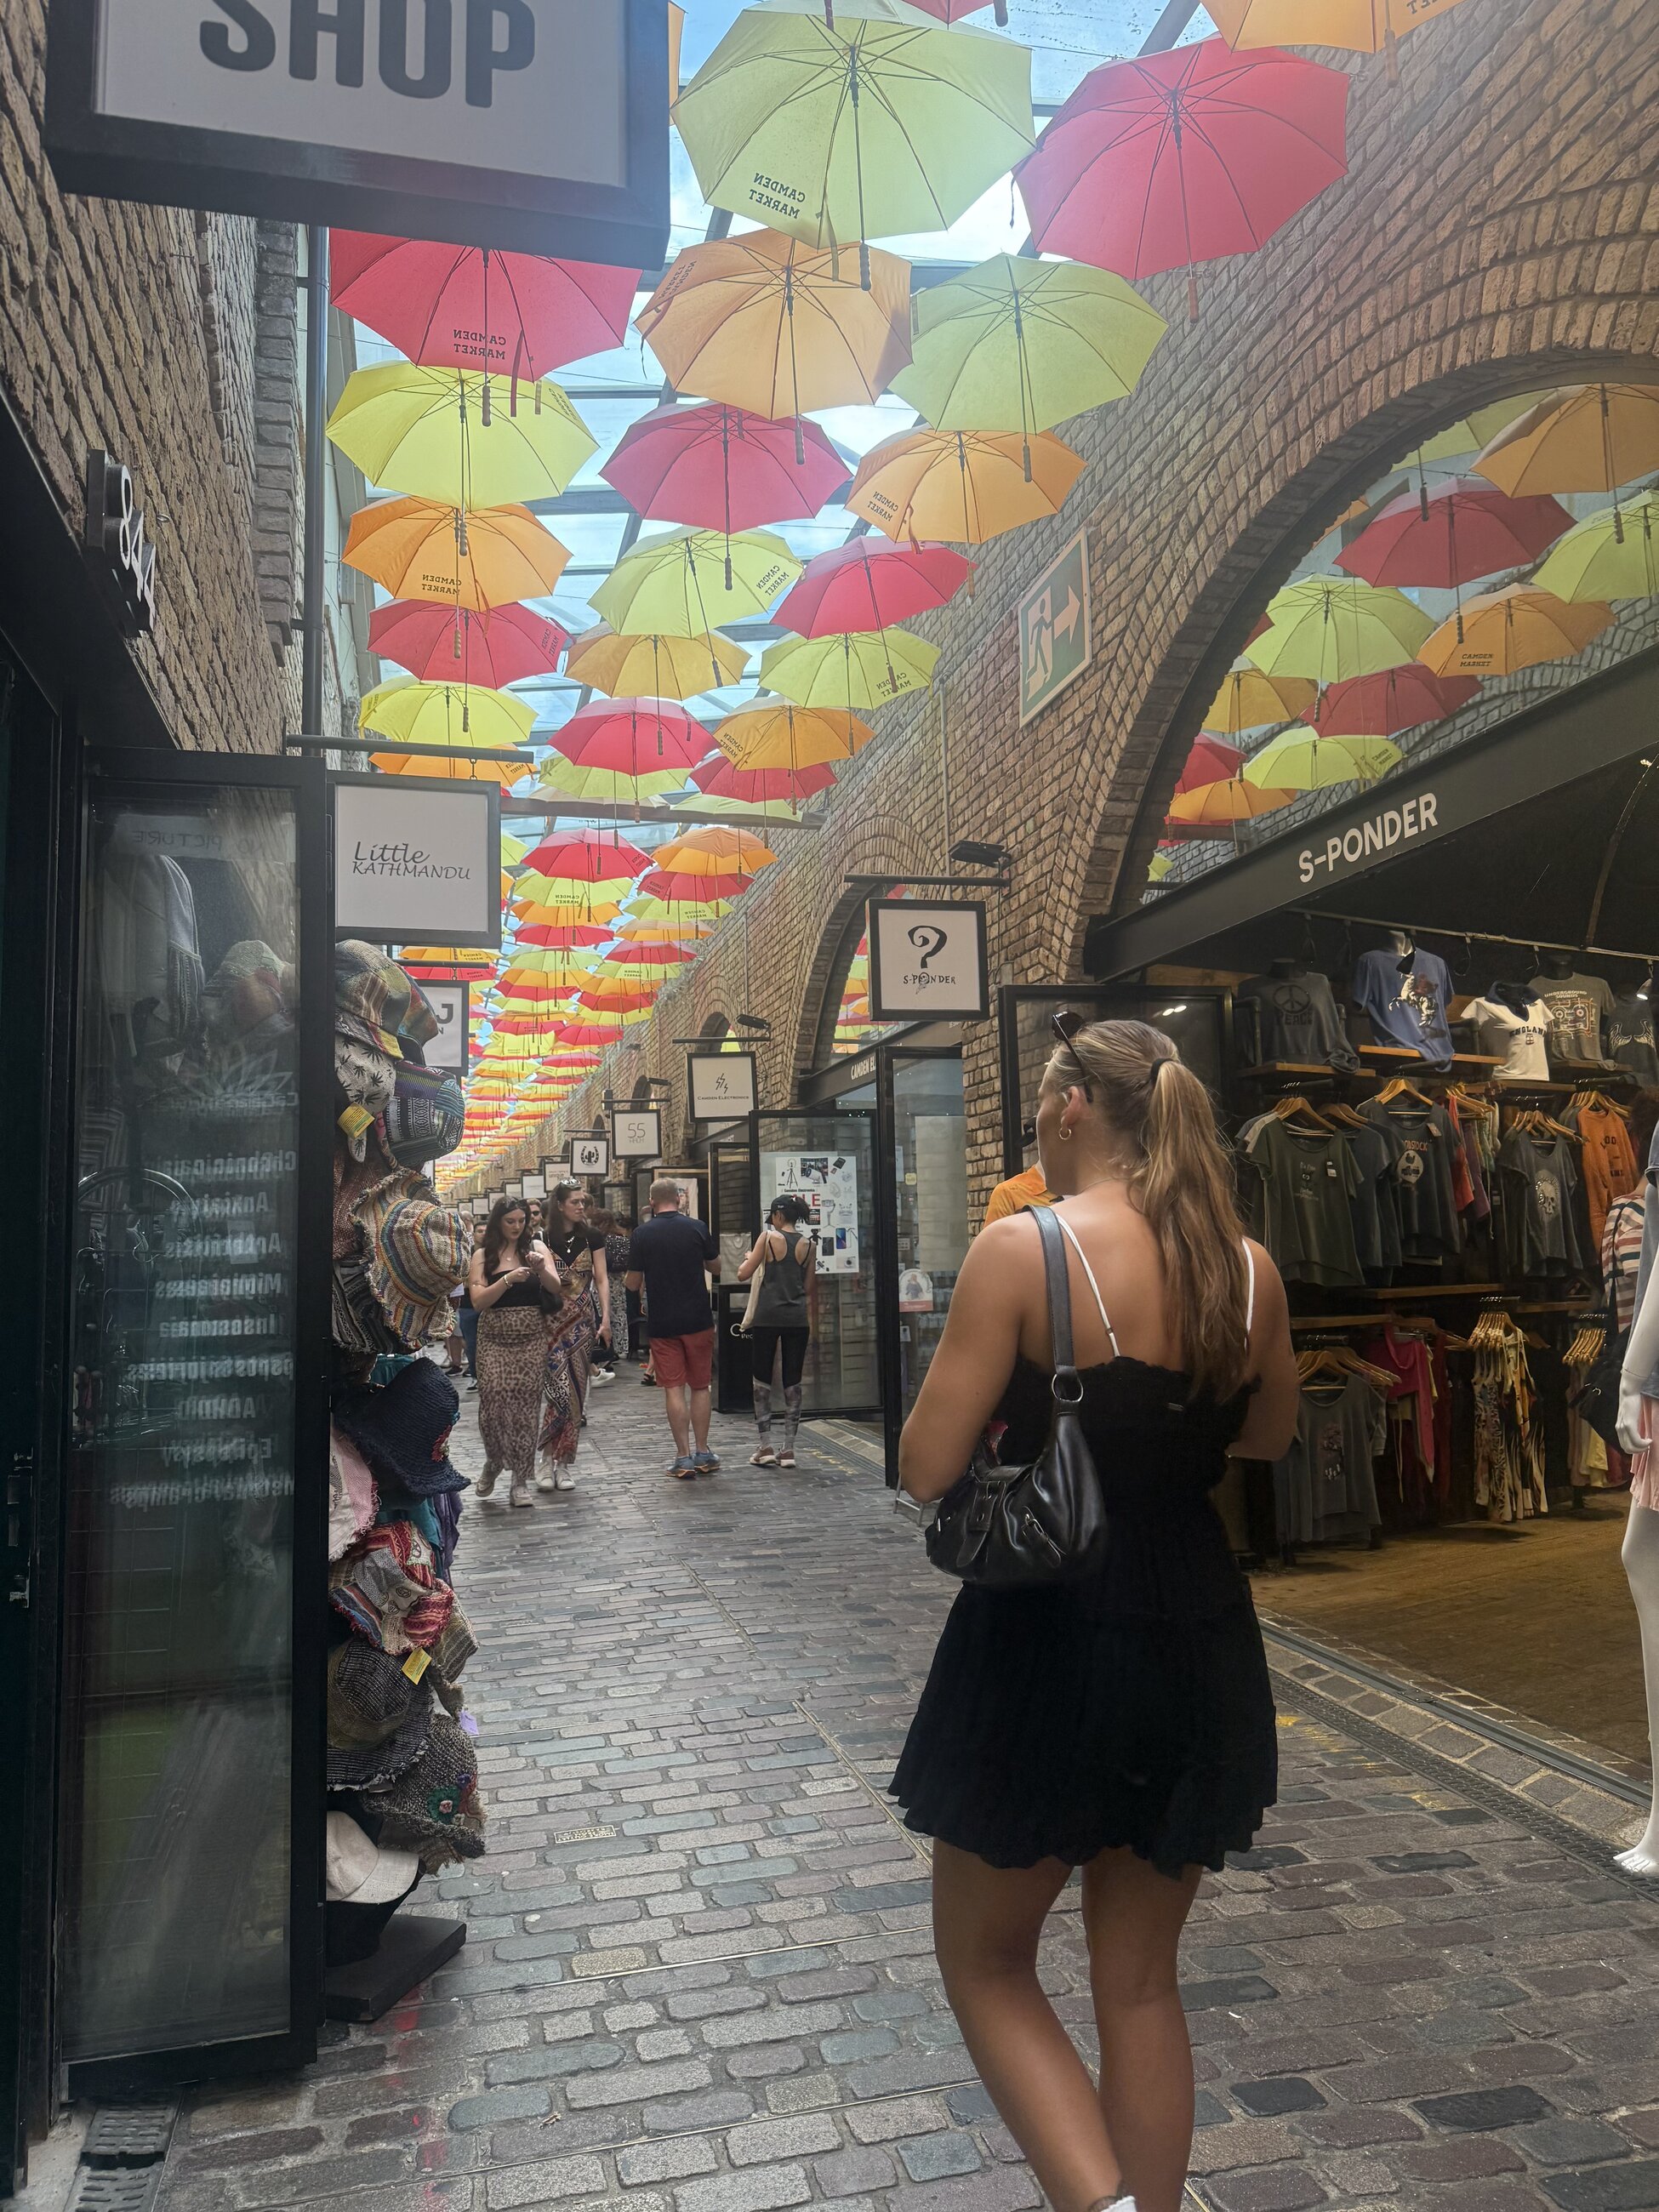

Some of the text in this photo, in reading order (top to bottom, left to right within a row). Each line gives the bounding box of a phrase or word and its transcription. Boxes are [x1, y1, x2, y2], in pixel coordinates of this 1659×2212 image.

[200, 0, 535, 108] SHOP
[1298, 792, 1439, 883] S-PONDER
[354, 841, 430, 864] Little
[352, 861, 471, 880] KATHMANDU
[628, 1123, 646, 1138] 55
